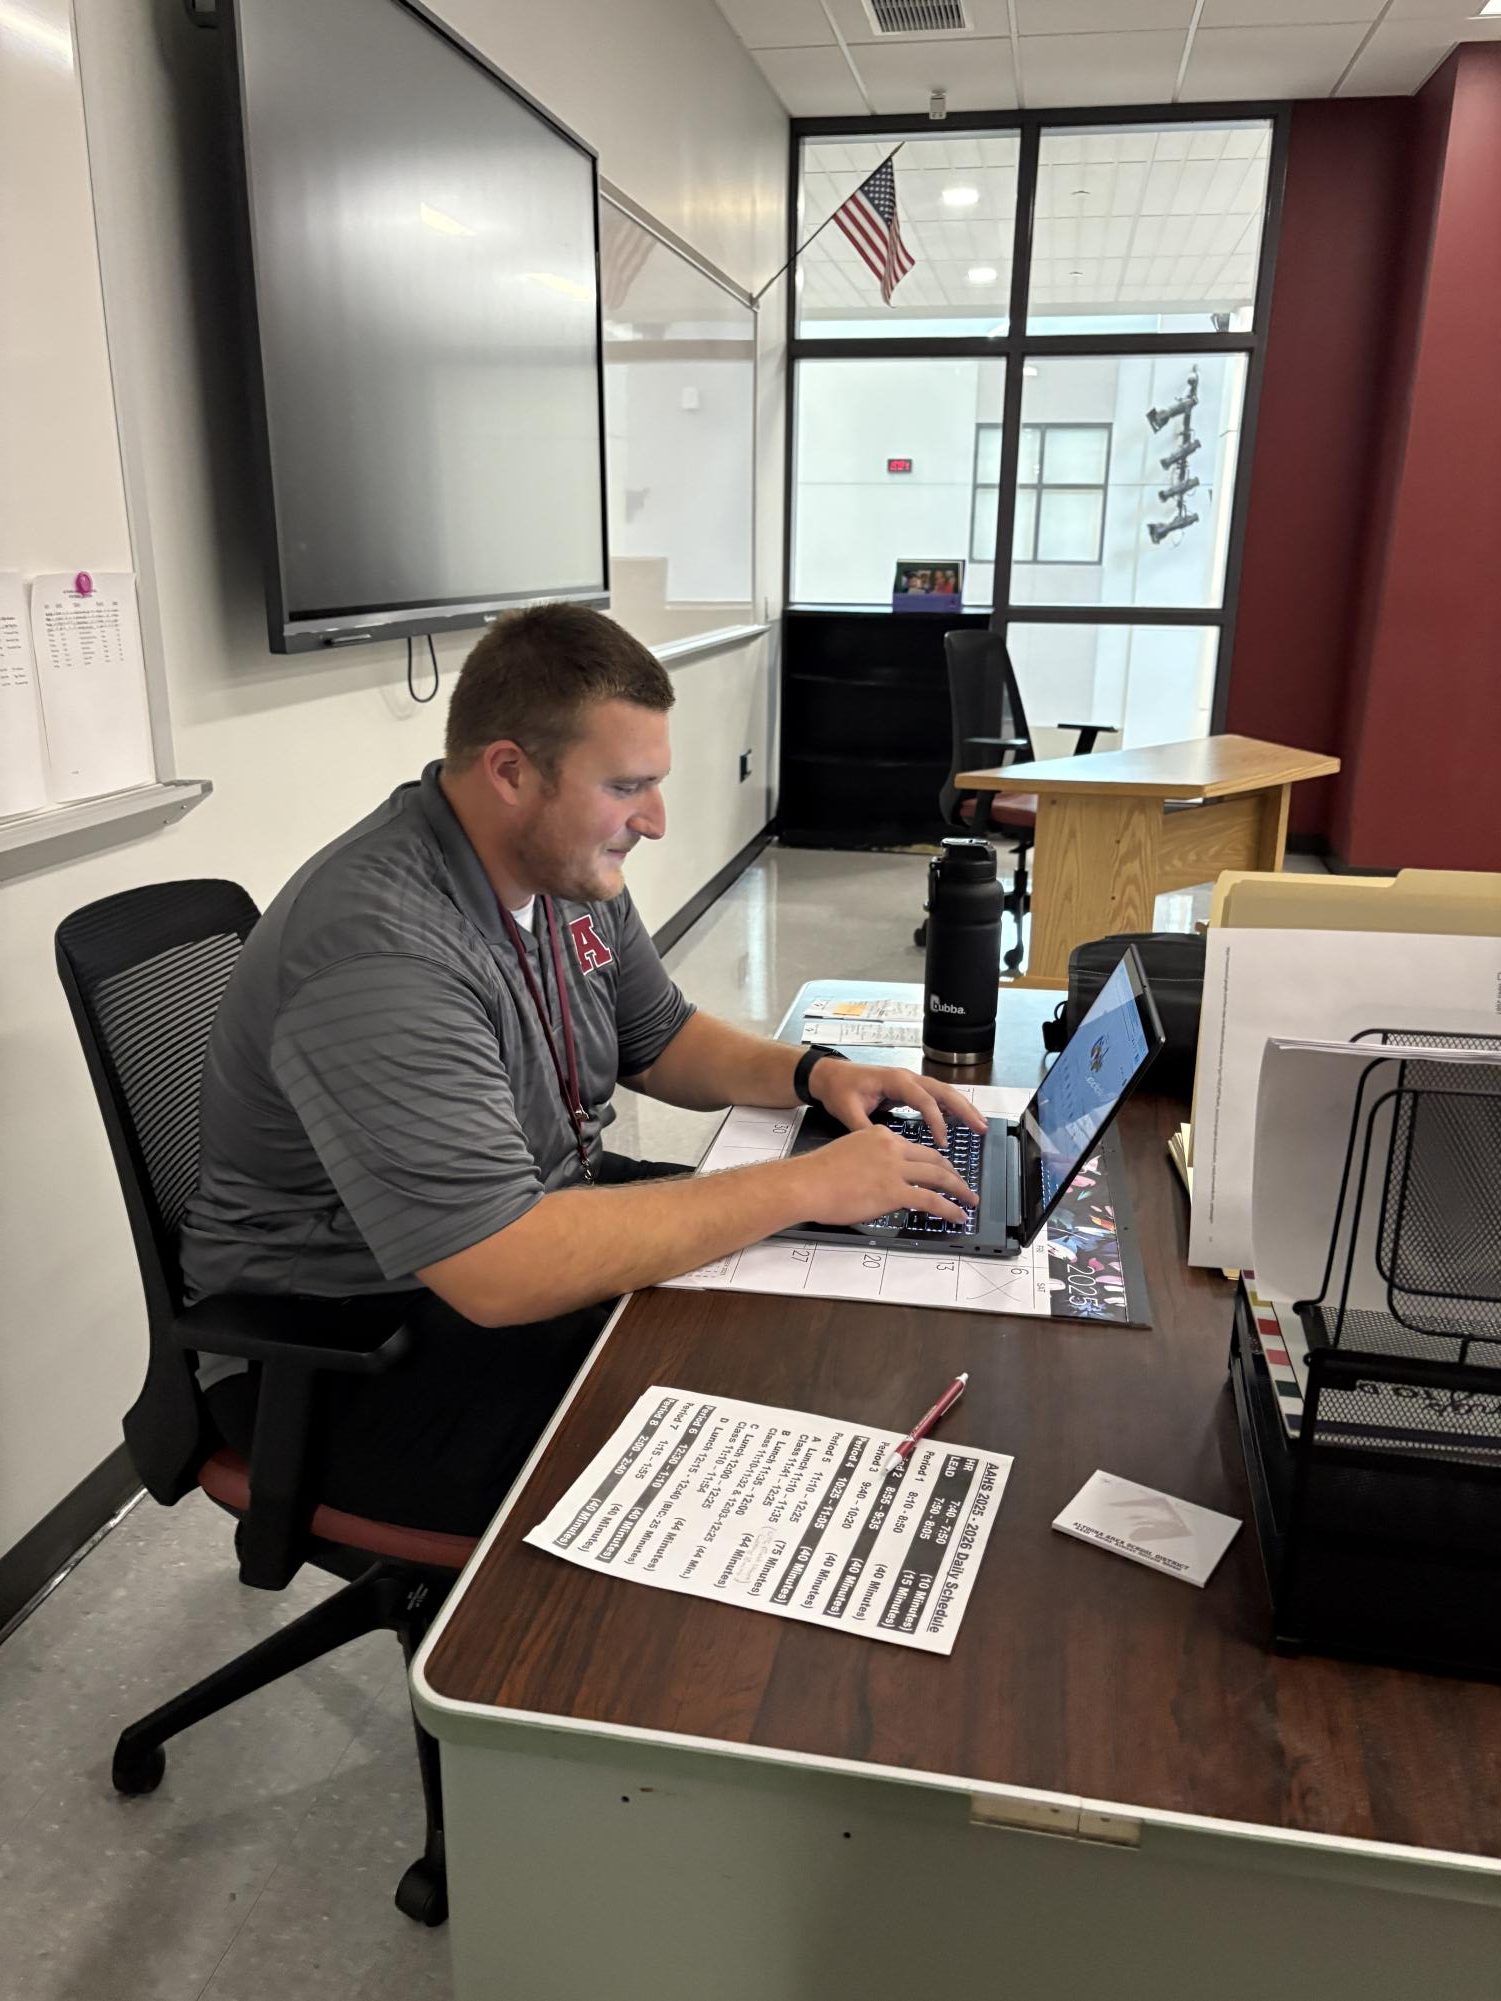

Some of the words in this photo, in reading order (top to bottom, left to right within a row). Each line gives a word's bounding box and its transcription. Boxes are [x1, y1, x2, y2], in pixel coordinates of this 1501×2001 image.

[569, 914, 612, 976] A
[791, 1249, 810, 1263] 27
[862, 1254, 882, 1269] 20
[936, 1261, 955, 1272] 13
[1010, 1268, 1029, 1276] 6
[1036, 1282, 1046, 1293] SAT
[1066, 1263, 1099, 1307] 2025
[651, 1398, 676, 1419] Period
[671, 1401, 695, 1423] Period
[690, 1404, 715, 1427] Period
[699, 1426, 726, 1451] Lunch
[725, 1420, 749, 1443] Class
[810, 1435, 822, 1443] A
[628, 1434, 649, 1452] 2:00
[649, 1439, 669, 1456] 1:15
[665, 1443, 689, 1465] 12:30
[731, 1433, 756, 1458] Lunch
[764, 1440, 787, 1464] Lunch
[788, 1433, 810, 1456] Class
[822, 1431, 845, 1456] Period
[845, 1435, 868, 1461] Period
[869, 1441, 890, 1466] Period
[611, 1456, 633, 1475] 2:40
[686, 1452, 708, 1473] 12:15
[712, 1444, 735, 1465] 11:10
[796, 1447, 817, 1471] Lunch
[916, 1450, 935, 1476] Period
[961, 1458, 976, 1472] HR
[633, 1461, 653, 1479] 1:55
[718, 1458, 740, 1479] 12:00
[751, 1464, 772, 1486] 11:35
[777, 1457, 797, 1477] 11:41
[867, 1465, 879, 1473] 3
[942, 1455, 960, 1478] LEAD
[978, 1462, 1000, 1492] AAHS
[650, 1470, 670, 1488] 1:10
[667, 1479, 690, 1500] 12:40
[694, 1471, 717, 1493] 11:54
[783, 1471, 804, 1493] 11:10
[803, 1470, 824, 1493] 11:10
[828, 1475, 848, 1499] 10:25
[854, 1480, 872, 1499] 9:40
[582, 1496, 602, 1511] (40
[699, 1486, 722, 1509] 12:25
[733, 1492, 756, 1516] 12:00
[760, 1483, 782, 1507] 12:25
[878, 1485, 896, 1504] 8:55
[901, 1490, 918, 1509] 8:10
[928, 1496, 945, 1515] 7:50
[970, 1492, 989, 1517] 2025
[603, 1501, 624, 1516] (40
[625, 1505, 645, 1520] (40
[653, 1500, 675, 1519] (BIC:
[766, 1499, 788, 1523] 11:35
[787, 1499, 809, 1523] 12:25
[812, 1504, 834, 1529] 11:05
[839, 1505, 860, 1529] 10:20
[944, 1499, 961, 1518] 7:40
[554, 1510, 592, 1546] Minutes)
[647, 1518, 662, 1529] 25
[666, 1516, 687, 1532] (44
[866, 1510, 884, 1530] 9:35
[890, 1514, 908, 1534] 8:50
[917, 1519, 935, 1540] 8:05
[575, 1515, 614, 1553] Minutes)
[597, 1520, 636, 1560] Minutes)
[735, 1532, 755, 1548] (44
[934, 1524, 951, 1545] 7:50
[958, 1522, 978, 1550] 2026
[621, 1528, 656, 1565] Minutes)
[641, 1531, 679, 1572] Minutes)
[769, 1539, 788, 1555] (75
[794, 1545, 813, 1562] (40
[712, 1548, 746, 1589] Minutes)
[819, 1551, 838, 1568] (40
[845, 1557, 864, 1574] (40
[945, 1550, 969, 1579] Daily
[746, 1555, 779, 1597] Minutes)
[869, 1562, 888, 1580] (40
[897, 1568, 916, 1586] (15
[915, 1572, 933, 1590] (10
[773, 1561, 805, 1604] Minutes)
[799, 1567, 830, 1610] Minutes)
[825, 1573, 855, 1616] Minutes)
[851, 1579, 880, 1621] Minutes)
[879, 1585, 909, 1628] Minutes)
[898, 1589, 926, 1632] Minutes)
[927, 1580, 958, 1635] Schedule
